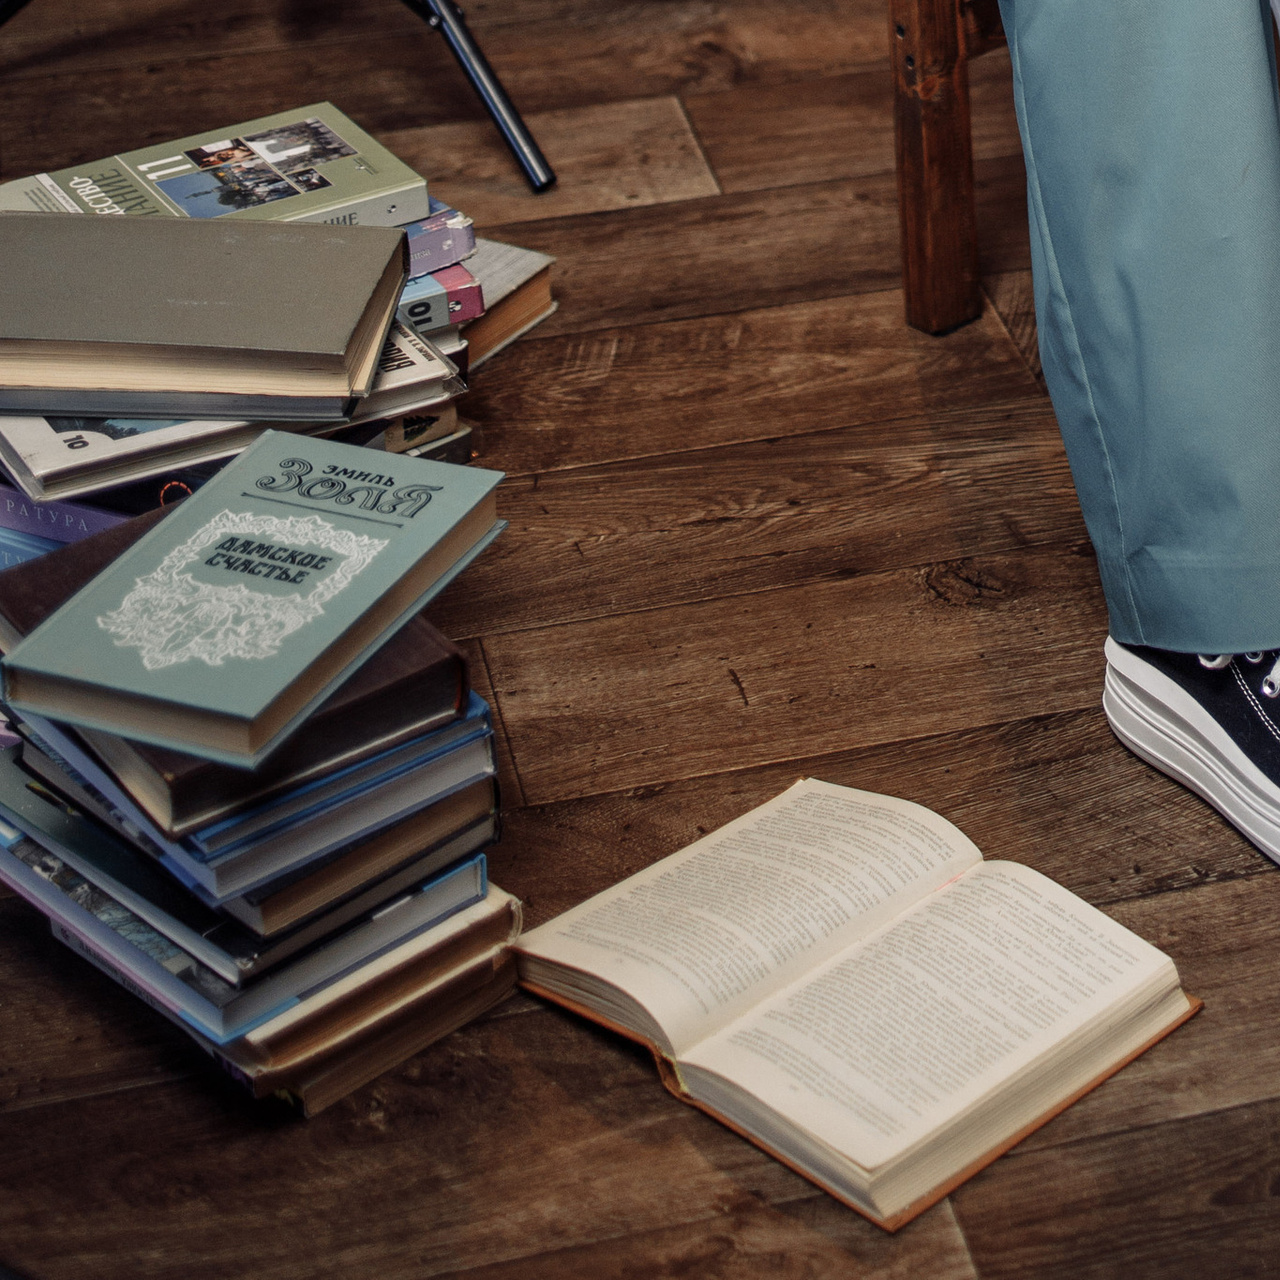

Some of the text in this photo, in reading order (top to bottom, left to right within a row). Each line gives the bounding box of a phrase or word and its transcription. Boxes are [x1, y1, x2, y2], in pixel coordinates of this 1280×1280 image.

[136, 154, 193, 180] 11
[408, 302, 432, 326] 10
[62, 433, 90, 450] 10
[255, 458, 444, 518] ЗОЛЯ
[322, 464, 395, 488] ЭМИЛЬ
[215, 536, 333, 571] ДАМСКОЕ
[205, 552, 311, 585] СЧАСТЬЕ
